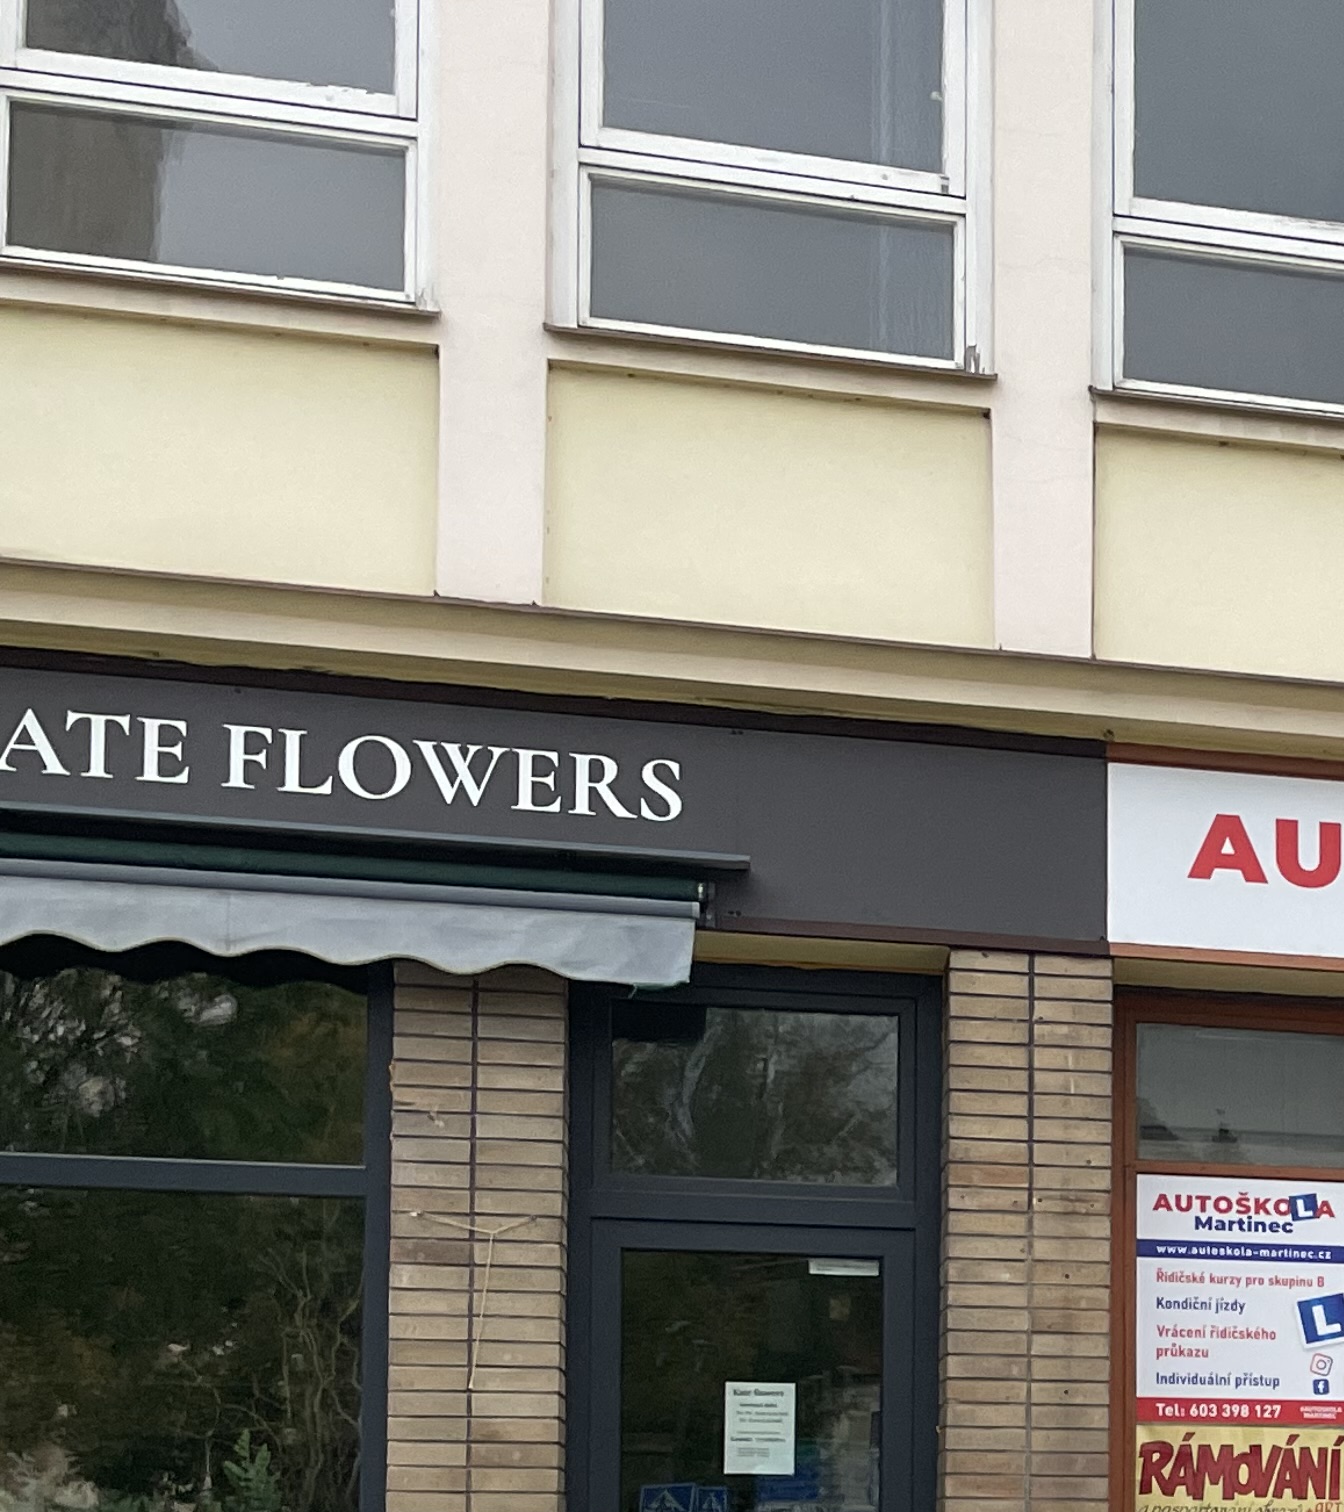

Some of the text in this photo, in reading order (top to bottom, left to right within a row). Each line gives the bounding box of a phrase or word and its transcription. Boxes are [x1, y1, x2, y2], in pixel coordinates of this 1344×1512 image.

[221, 724, 684, 822] FLOWERS
[1153, 1192, 1336, 1221] AUTOŠKOLA
[1195, 1216, 1294, 1234] Martinec
[1156, 1244, 1332, 1260] www.autoskola-martinec.cz
[1156, 1268, 1325, 1290] Řidičské kurzy pro skupinu B
[1156, 1297, 1246, 1315] Kondiční jízdy
[1156, 1325, 1277, 1341] Vrácení řidičského
[1156, 1343, 1209, 1360] průkazu
[1156, 1372, 1280, 1389] Individuální přístup
[1156, 1403, 1282, 1418] Tel: 603 398 127
